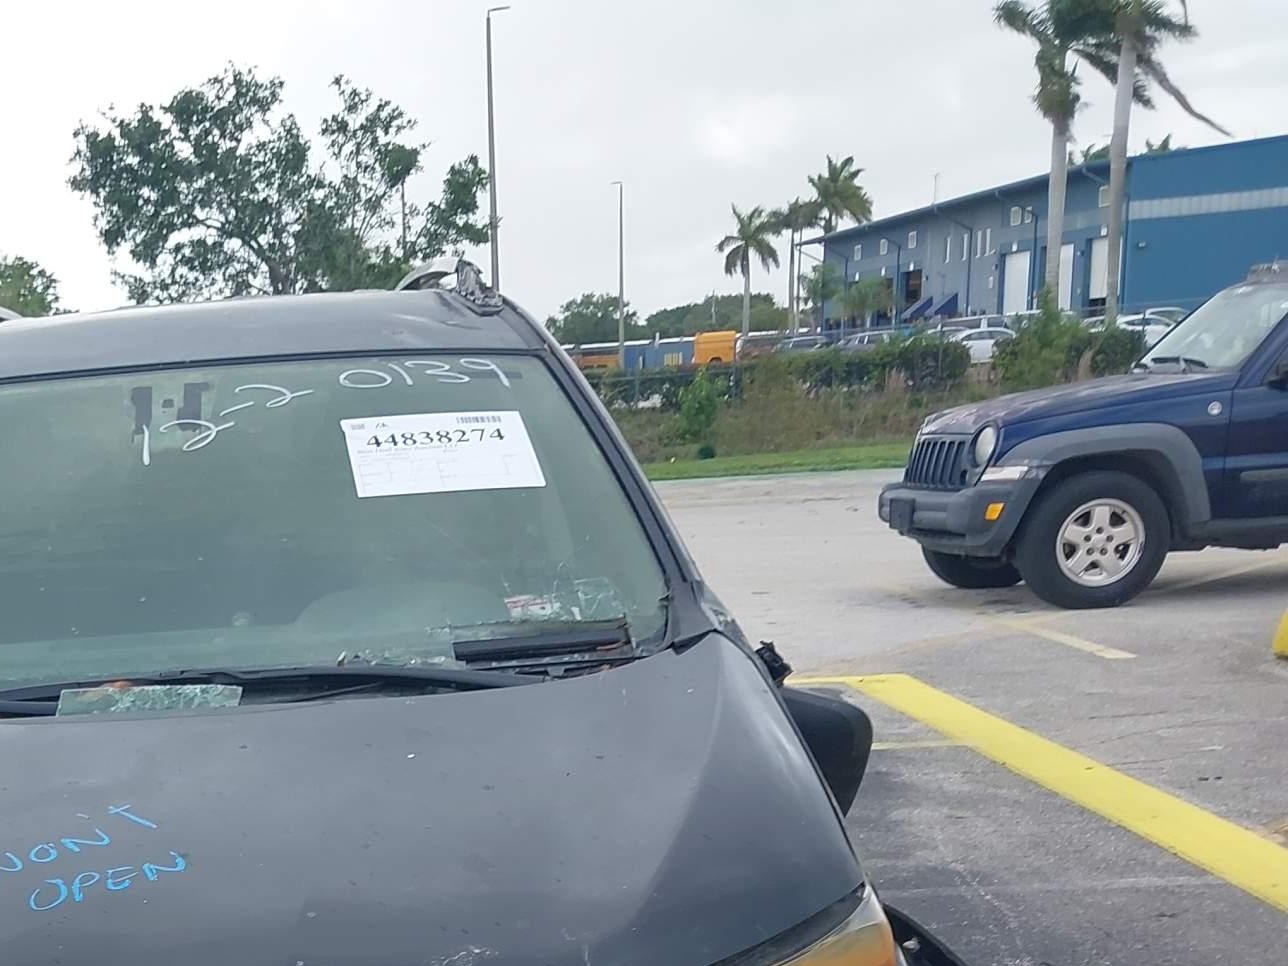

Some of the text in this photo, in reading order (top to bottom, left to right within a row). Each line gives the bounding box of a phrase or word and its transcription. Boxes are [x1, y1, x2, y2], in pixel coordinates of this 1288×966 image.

[339, 358, 511, 389] 0139
[366, 427, 505, 448] 44838274
[29, 850, 187, 911] OPEN
